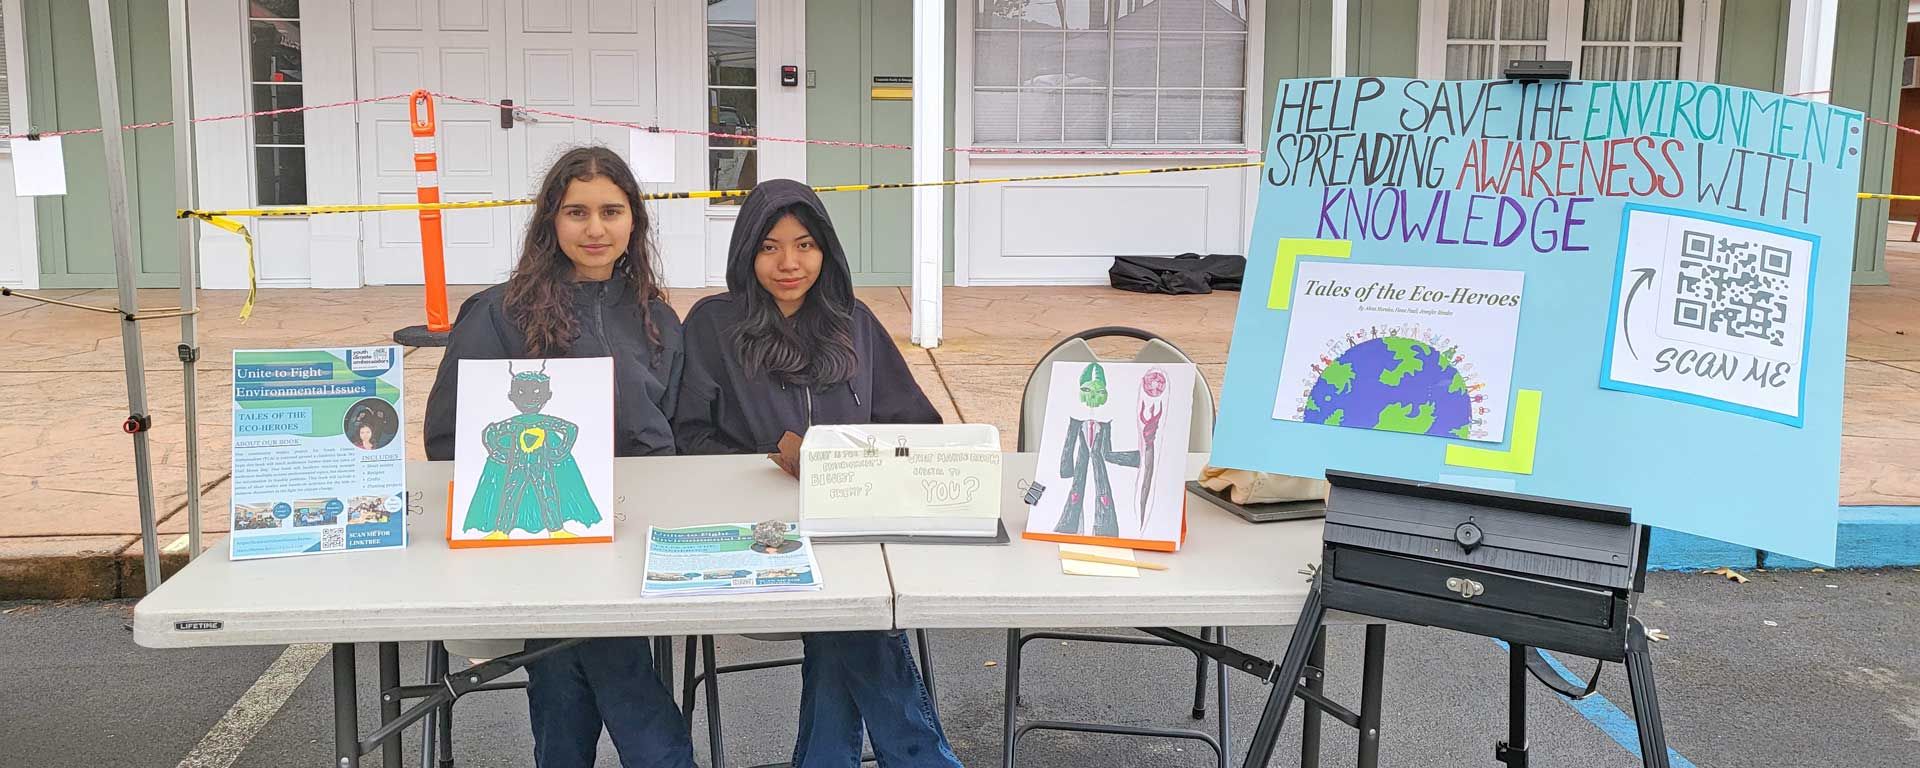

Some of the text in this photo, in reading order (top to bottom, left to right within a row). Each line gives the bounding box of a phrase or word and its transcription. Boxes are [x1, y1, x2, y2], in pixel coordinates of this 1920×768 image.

[1276, 77, 1862, 170] HELP SAVE THE ENVIRONMENT:
[1268, 132, 1813, 224] SPREADING AWARENESS WITH
[1316, 185, 1597, 253] KNOWLEDGE
[1304, 279, 1520, 307] Tales of the Eco-Heroes
[237, 367, 322, 380] Unite to Fight
[1654, 346, 1792, 389] SCAN ME
[236, 384, 366, 398] Environmental Issues
[239, 411, 306, 421] TALES OF THE
[239, 423, 299, 432] ECO-HEROES
[921, 476, 980, 503] YOU?
